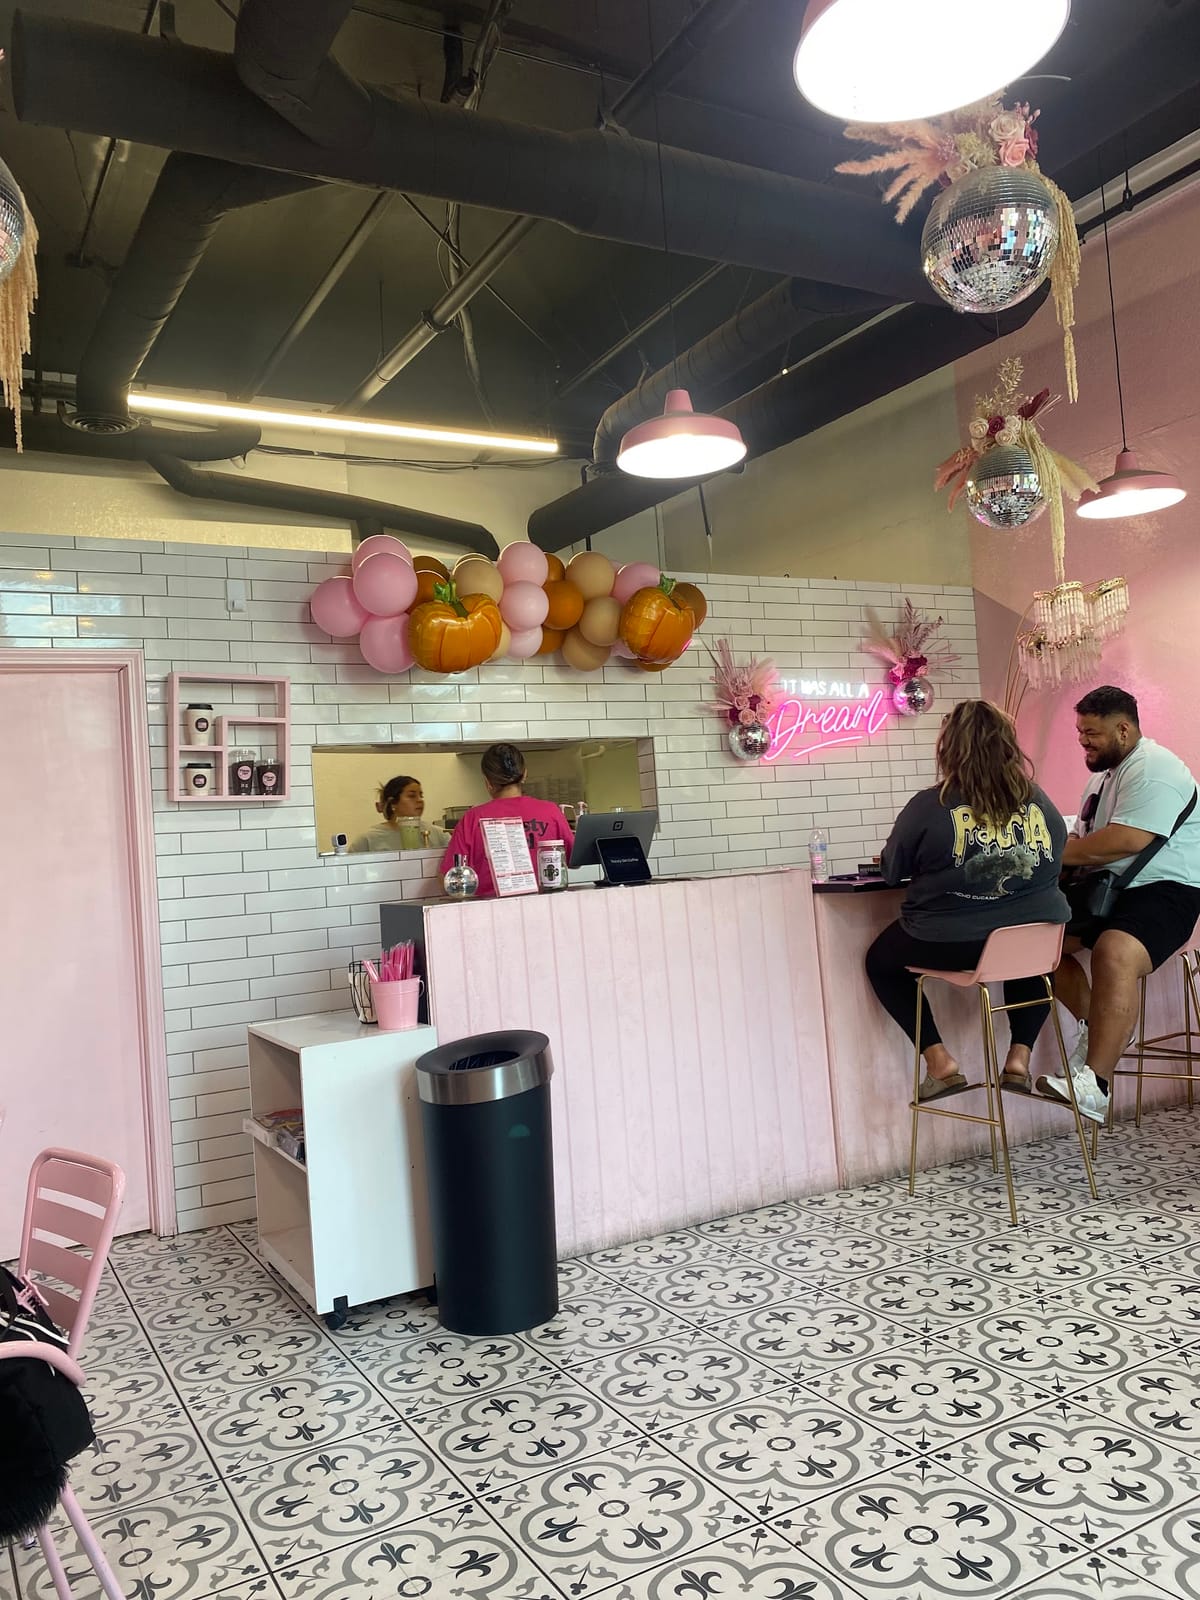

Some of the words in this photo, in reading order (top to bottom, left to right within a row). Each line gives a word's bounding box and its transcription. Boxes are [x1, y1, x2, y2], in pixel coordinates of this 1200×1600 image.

[782, 679, 797, 695] IT
[800, 679, 827, 696] WAS
[829, 681, 854, 698] ALL
[858, 682, 871, 698] A
[763, 690, 888, 761] Dream
